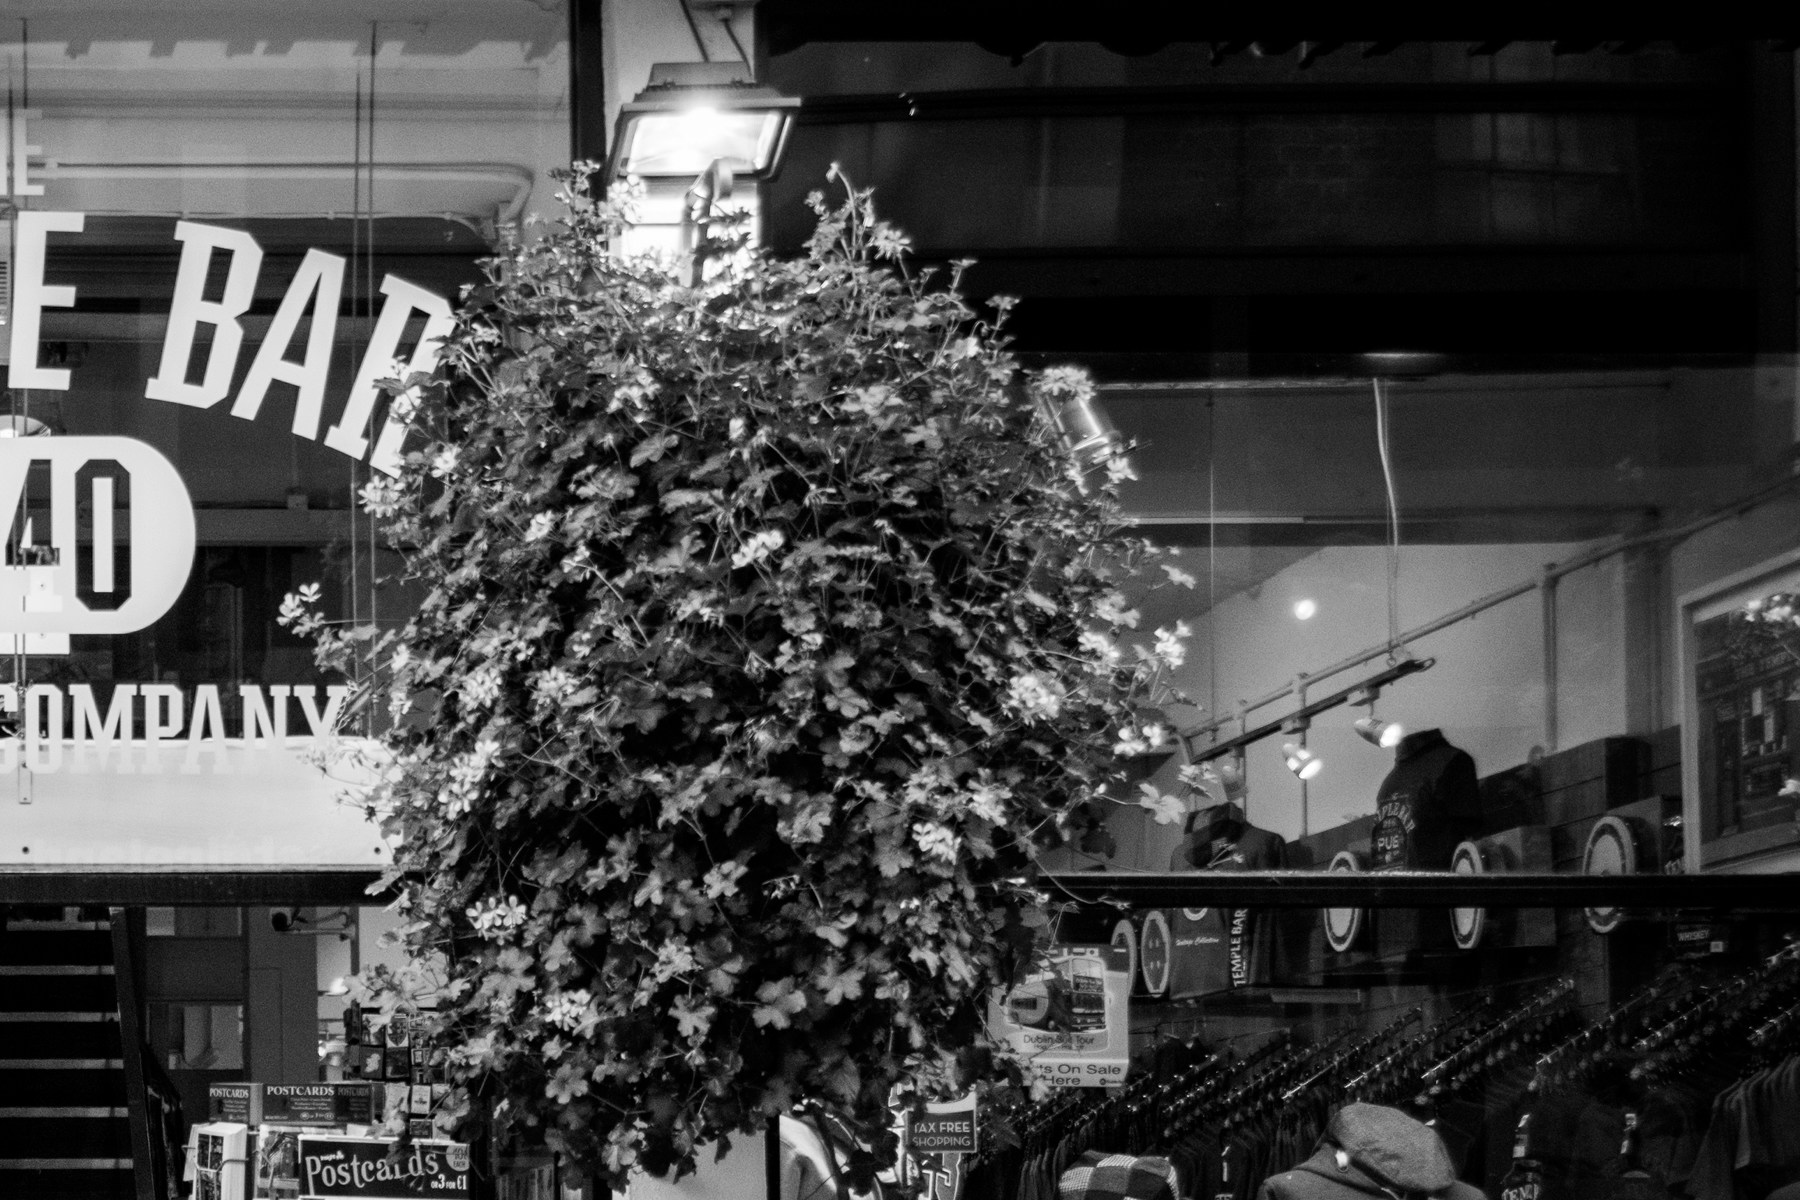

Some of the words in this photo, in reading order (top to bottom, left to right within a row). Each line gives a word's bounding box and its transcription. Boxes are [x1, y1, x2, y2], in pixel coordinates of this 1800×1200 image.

[144, 219, 457, 477] BAR
[1231, 908, 1248, 935] BAR
[1230, 936, 1247, 988] TEMPLE
[1076, 1034, 1095, 1045] Tour
[1058, 1063, 1081, 1075] On
[1086, 1063, 1121, 1075] Sale
[1044, 1074, 1081, 1086] Here
[209, 1087, 249, 1098] POSTCARDS
[266, 1085, 336, 1096] POSTCARDS
[914, 1122, 936, 1133] TAX
[939, 1121, 970, 1133] FREE
[913, 1136, 971, 1147] SHOPPING
[305, 1143, 439, 1196] Postcards
[438, 1174, 446, 1189] 3
